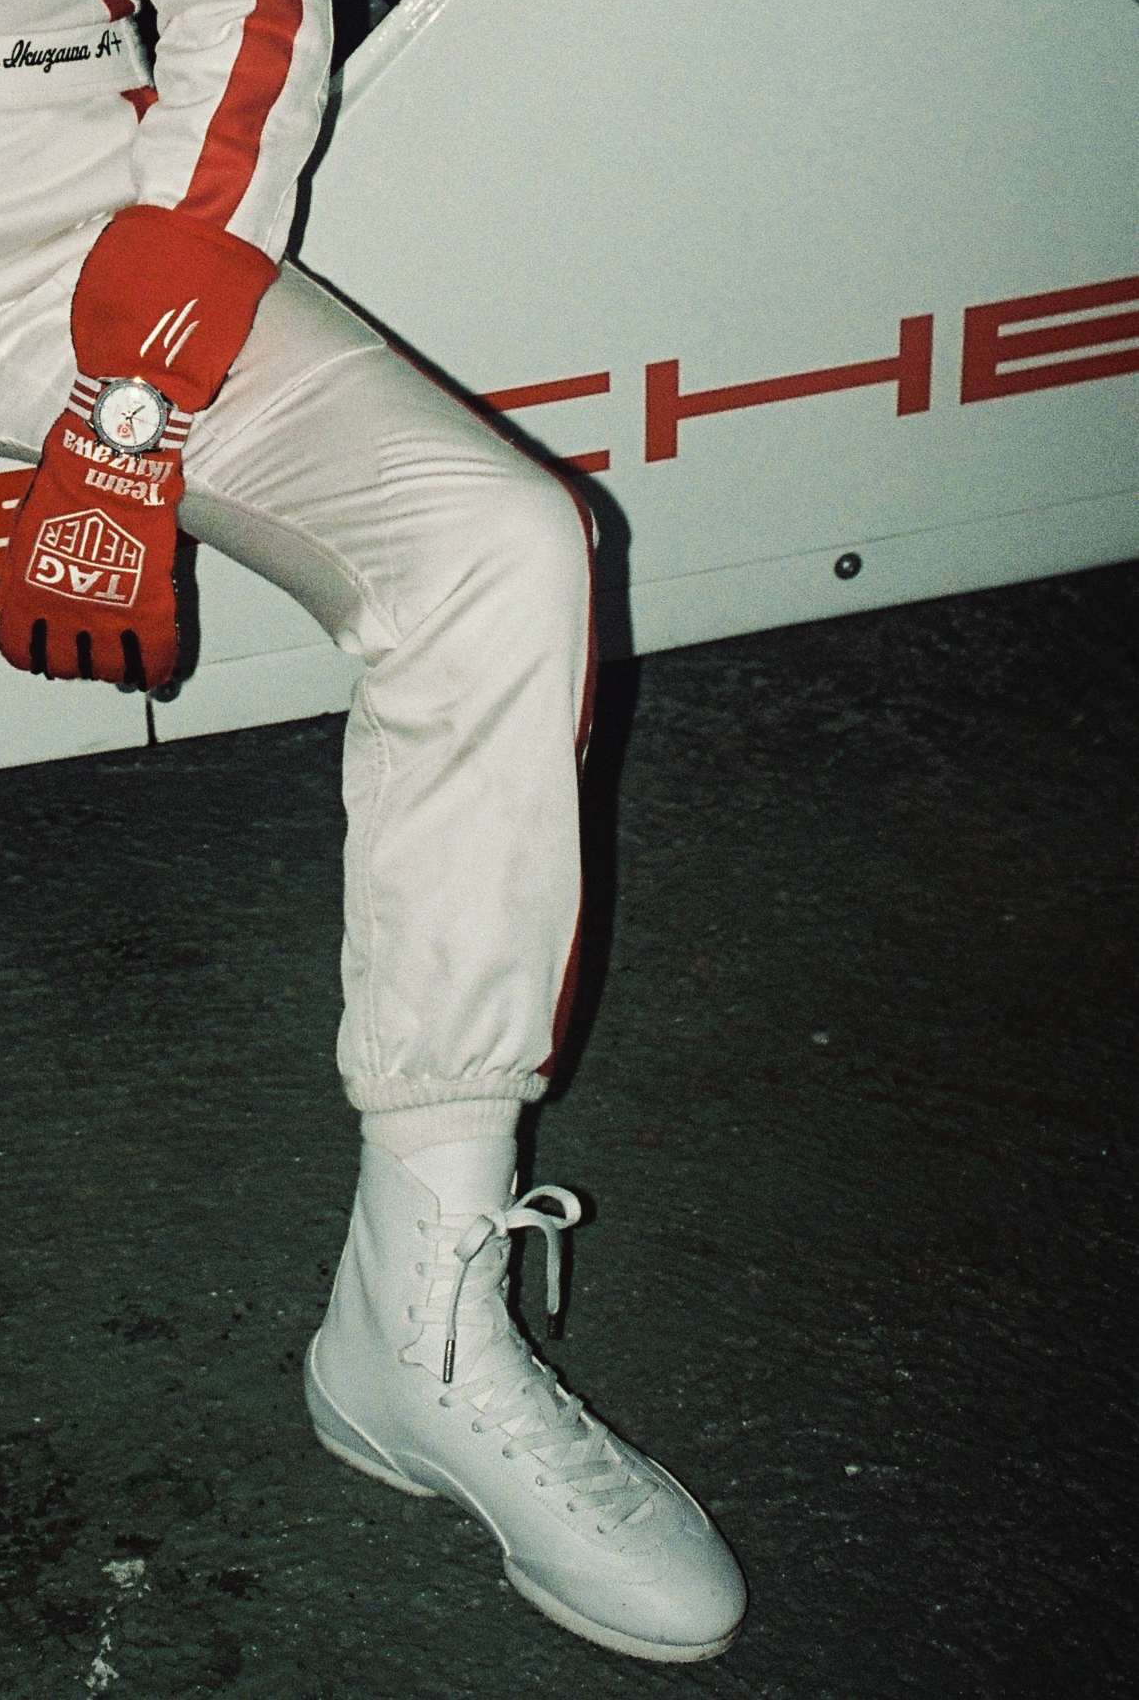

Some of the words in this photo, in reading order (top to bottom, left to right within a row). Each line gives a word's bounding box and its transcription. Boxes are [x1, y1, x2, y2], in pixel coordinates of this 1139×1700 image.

[3, 39, 91, 73] Ikuzawa
[62, 428, 173, 483] Ikuzawa
[85, 468, 165, 506] Team
[44, 516, 137, 567] HEUER
[35, 554, 127, 601] TAG
